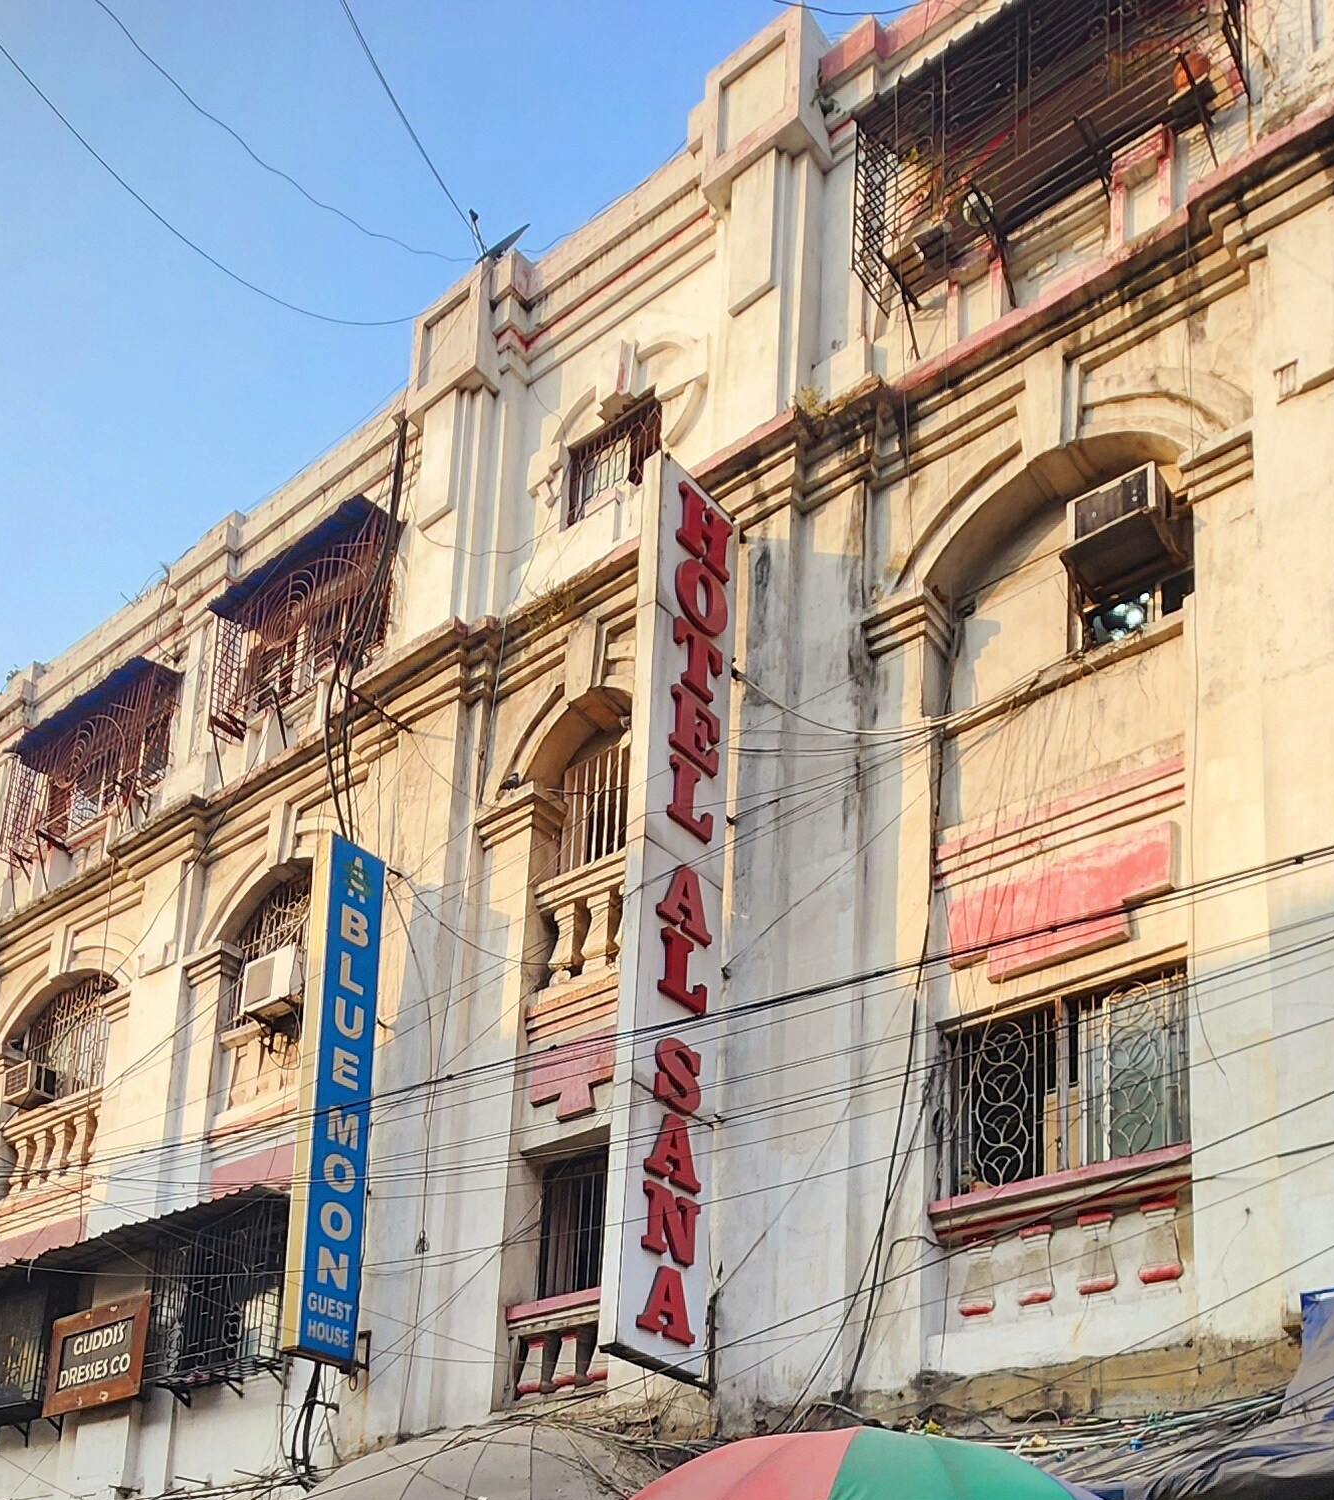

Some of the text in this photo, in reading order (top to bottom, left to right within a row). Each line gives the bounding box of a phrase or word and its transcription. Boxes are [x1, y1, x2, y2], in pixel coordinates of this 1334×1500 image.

[635, 480, 733, 1348] HOTEL AL SANA
[331, 904, 368, 1092] BLUE
[316, 1104, 360, 1291] MOON
[307, 1291, 353, 1322] GUEST
[73, 1322, 126, 1356] GUDDI'S
[306, 1318, 350, 1349] HOUSE
[58, 1353, 131, 1389] DRESSES CO
